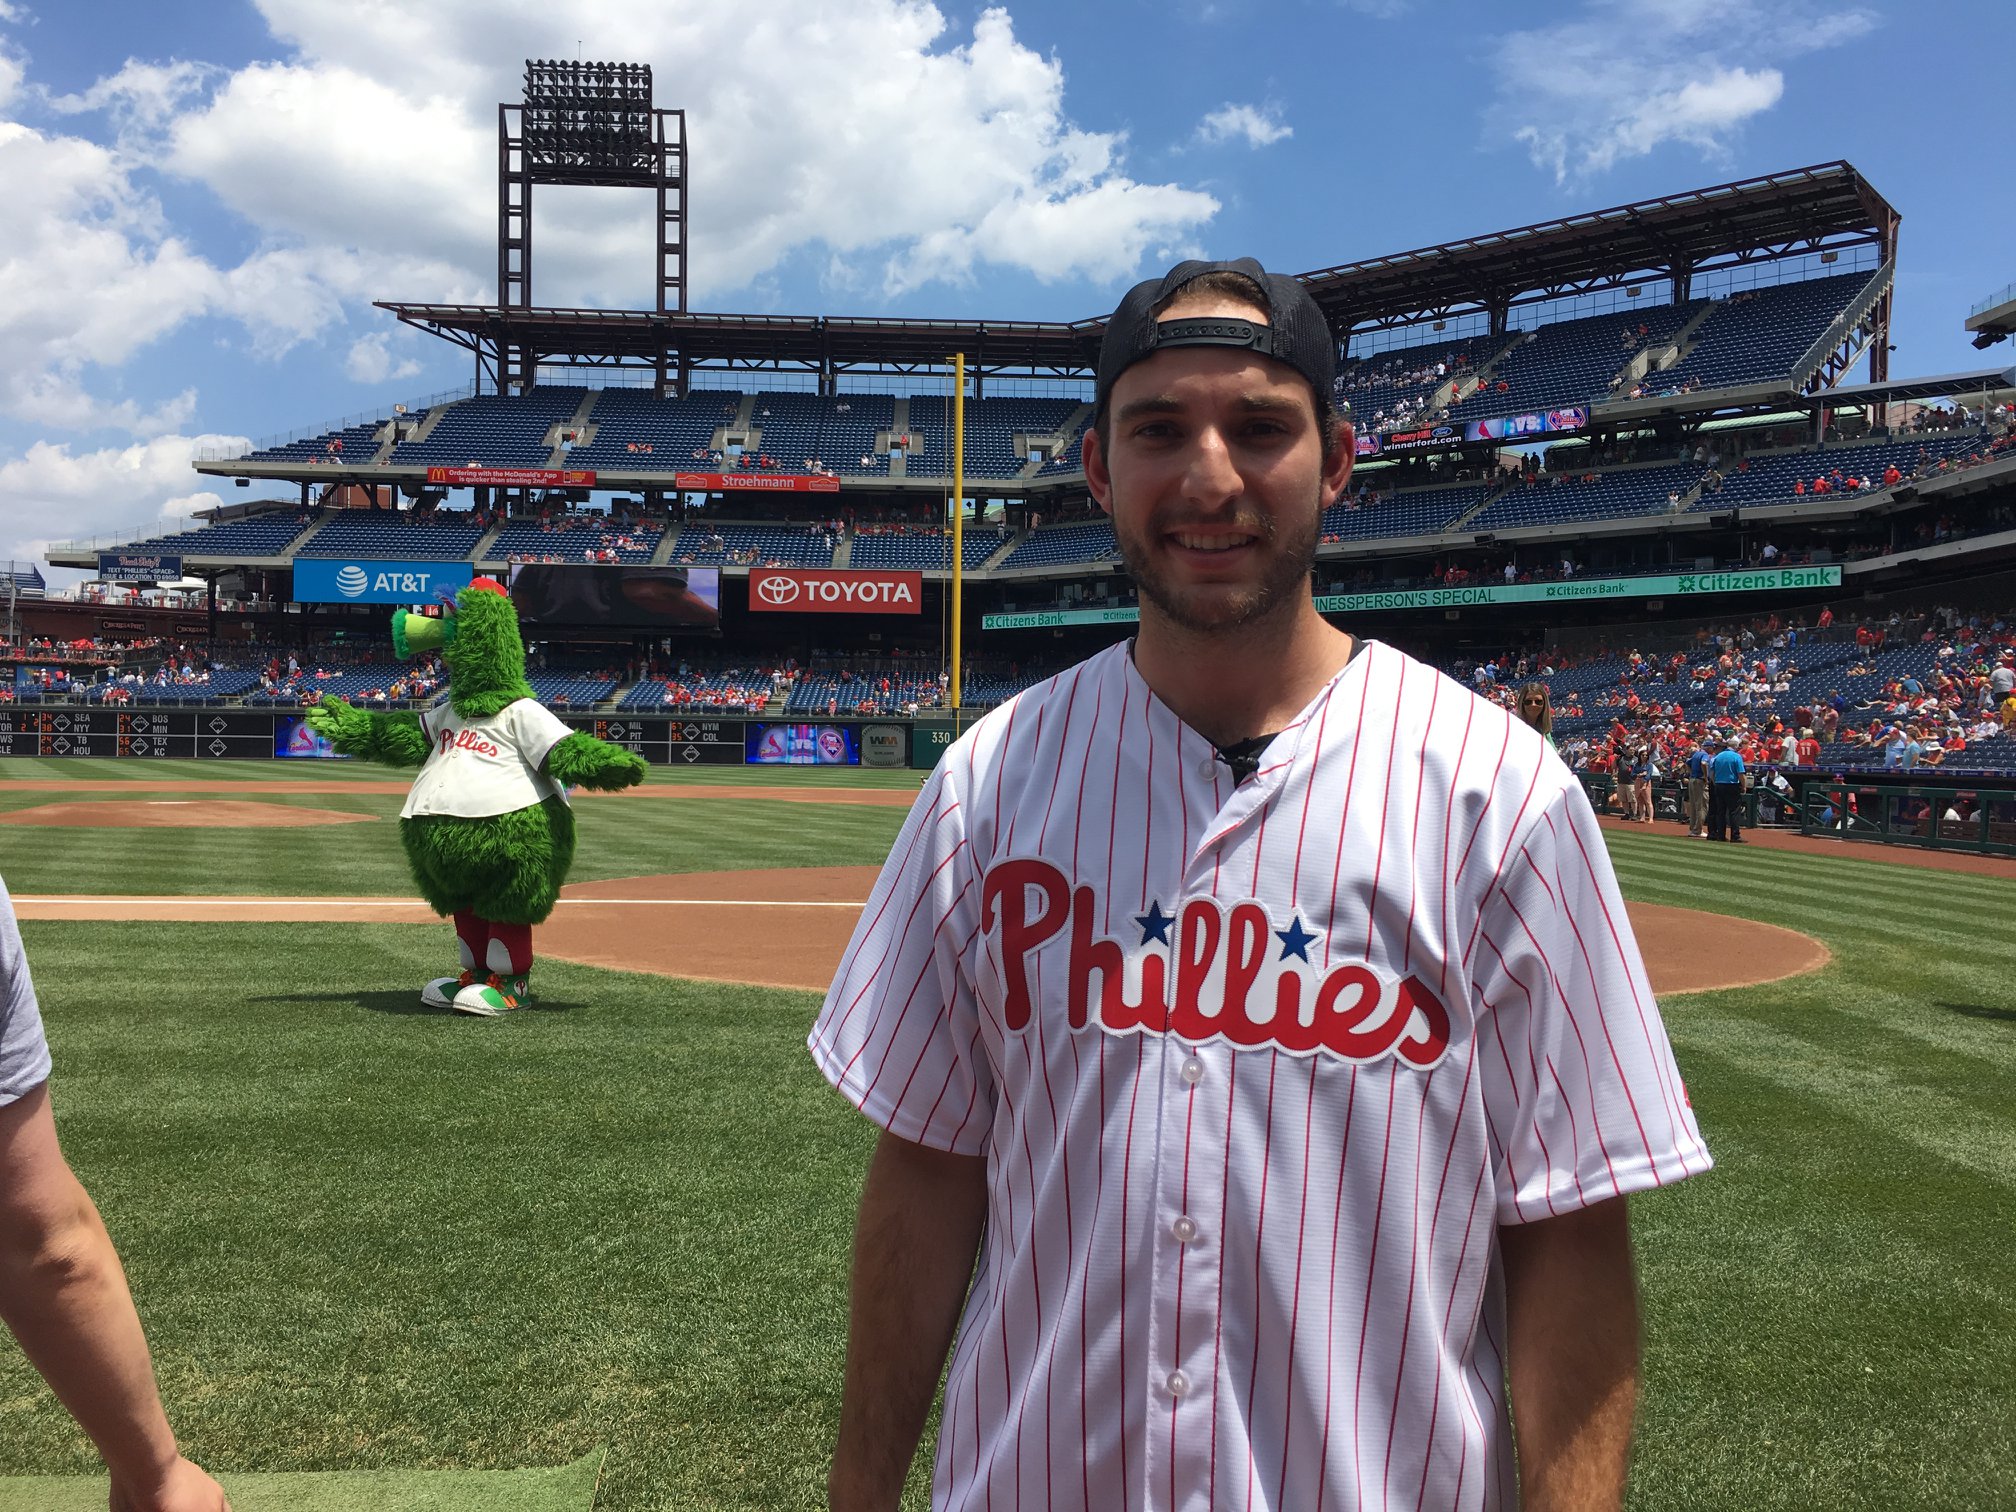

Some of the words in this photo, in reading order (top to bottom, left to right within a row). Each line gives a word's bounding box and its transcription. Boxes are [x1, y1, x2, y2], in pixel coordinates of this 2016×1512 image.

[1515, 416, 1536, 431] VS
[1391, 433, 1417, 443] Cherry
[1417, 429, 1431, 439] Hill
[1383, 436, 1461, 451] winnerford.com
[449, 469, 477, 477] Ordering
[465, 476, 490, 484] quicker
[506, 477, 531, 485] stealing
[722, 475, 795, 488] Stroehmann
[373, 572, 431, 592] AT&T
[1698, 574, 1776, 591] Citizens
[1781, 568, 1831, 586] Bank
[803, 580, 913, 602] TOYOTA
[1557, 585, 1597, 595] Citizens
[1599, 583, 1625, 593] Bank
[1312, 592, 1427, 611] INESSPERSON'S
[1432, 589, 1496, 605] SPECIAL
[995, 615, 1036, 628] Citizens
[1038, 612, 1064, 625] Bank
[1109, 611, 1137, 620] Citizens
[42, 712, 52, 721] 34
[75, 713, 91, 722] SEA
[152, 715, 168, 723] BOS
[0, 722, 12, 732] OR
[73, 724, 90, 732] NYY
[152, 725, 168, 734] MIN
[629, 721, 643, 730] MIL
[702, 723, 719, 731] NYM
[0, 734, 13, 743] WS
[77, 736, 87, 744] TB
[629, 732, 643, 740] PIT
[703, 733, 719, 741] COL
[870, 736, 897, 745] WM
[931, 731, 950, 744] 330
[152, 737, 168, 745] TEX
[795, 739, 812, 749] VS
[0, 745, 11, 754] LE
[73, 746, 91, 755] HOU
[154, 748, 165, 756] KC
[1801, 747, 1811, 756] 11
[982, 857, 1451, 1068] Phillies
